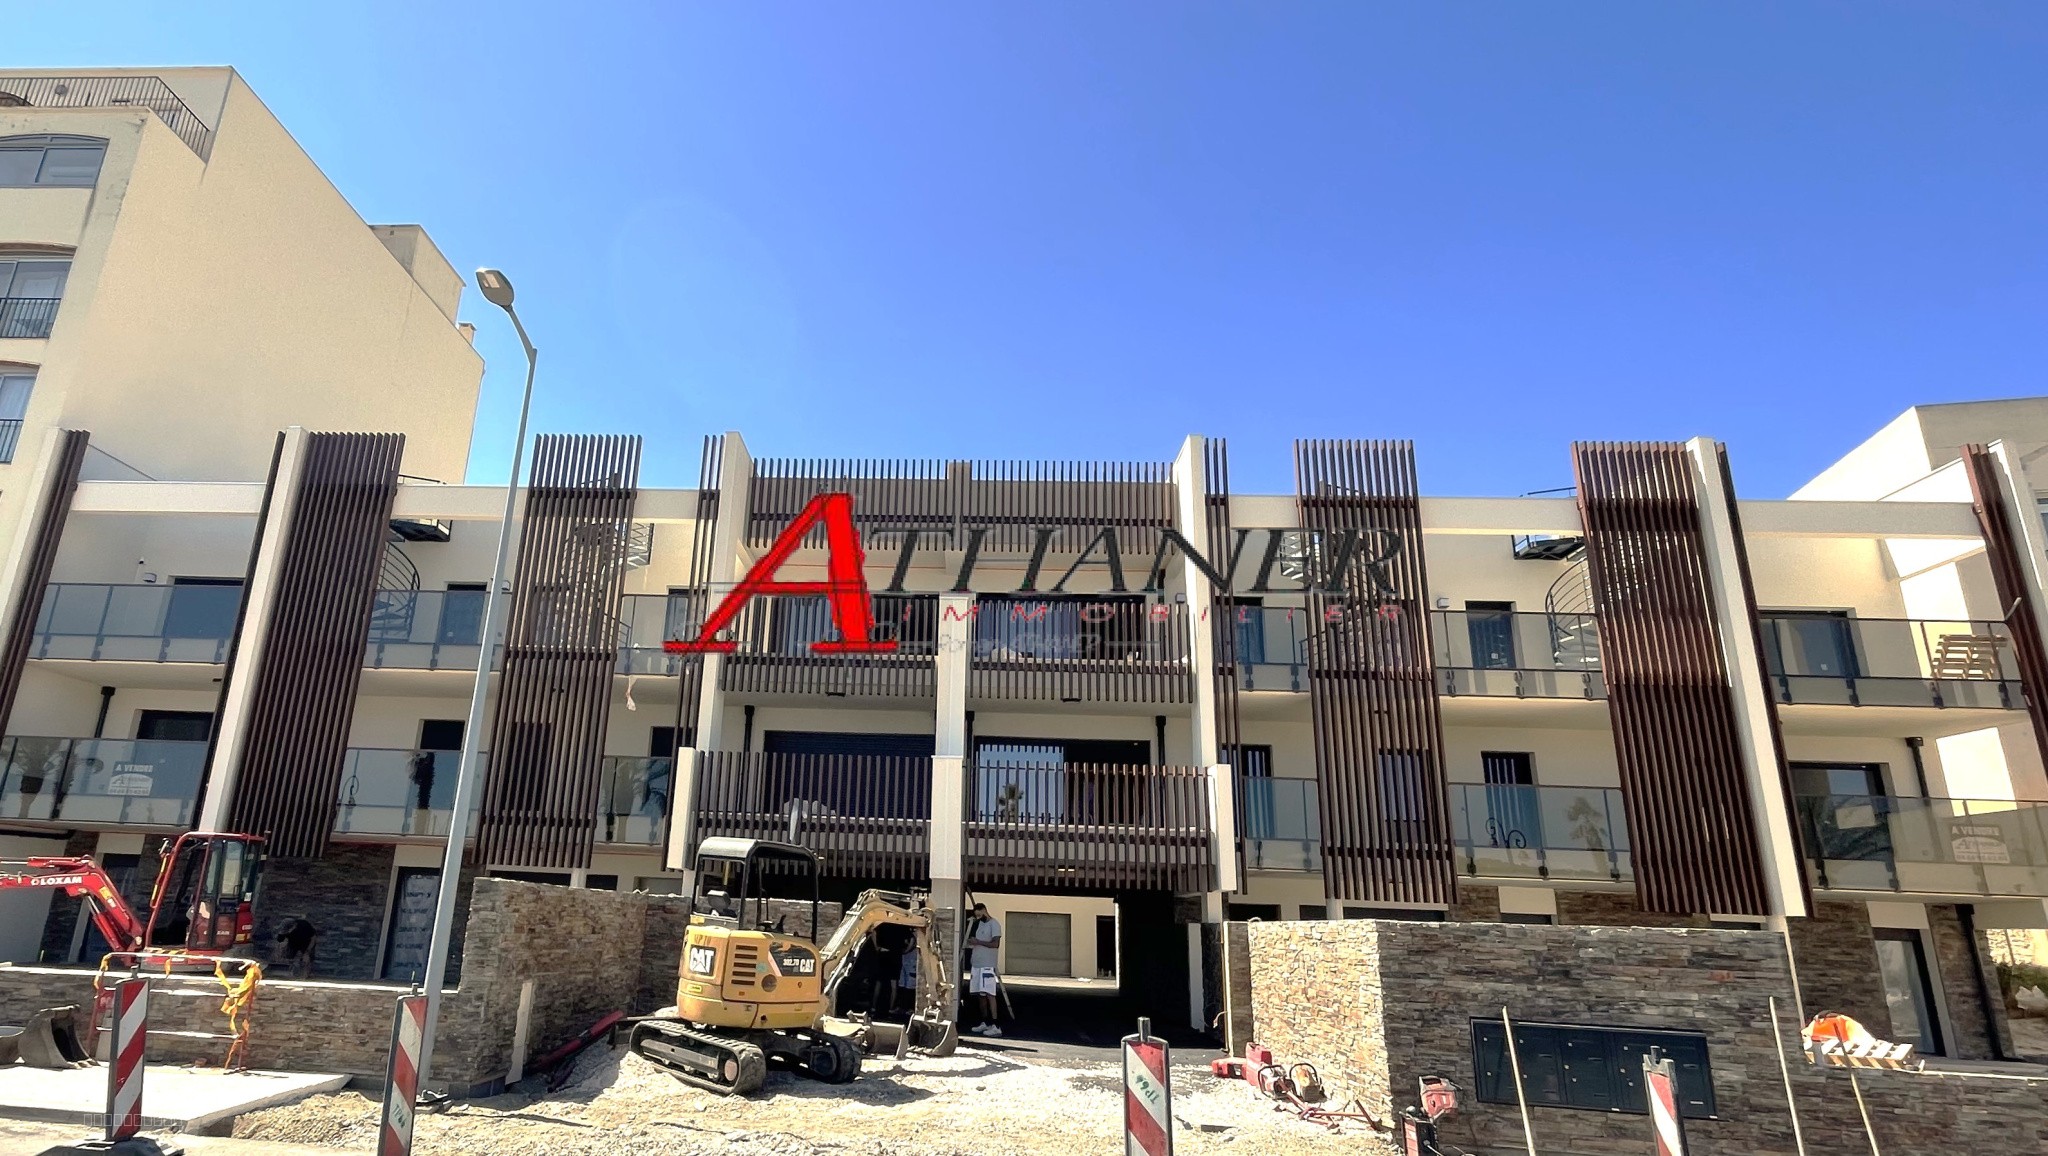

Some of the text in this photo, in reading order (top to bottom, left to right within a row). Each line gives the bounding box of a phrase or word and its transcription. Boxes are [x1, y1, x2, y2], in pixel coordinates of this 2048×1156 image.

[1952, 826, 1959, 834] A
[40, 876, 83, 886] LOXAM
[690, 947, 715, 973] CAT
[799, 958, 815, 973] CAT
